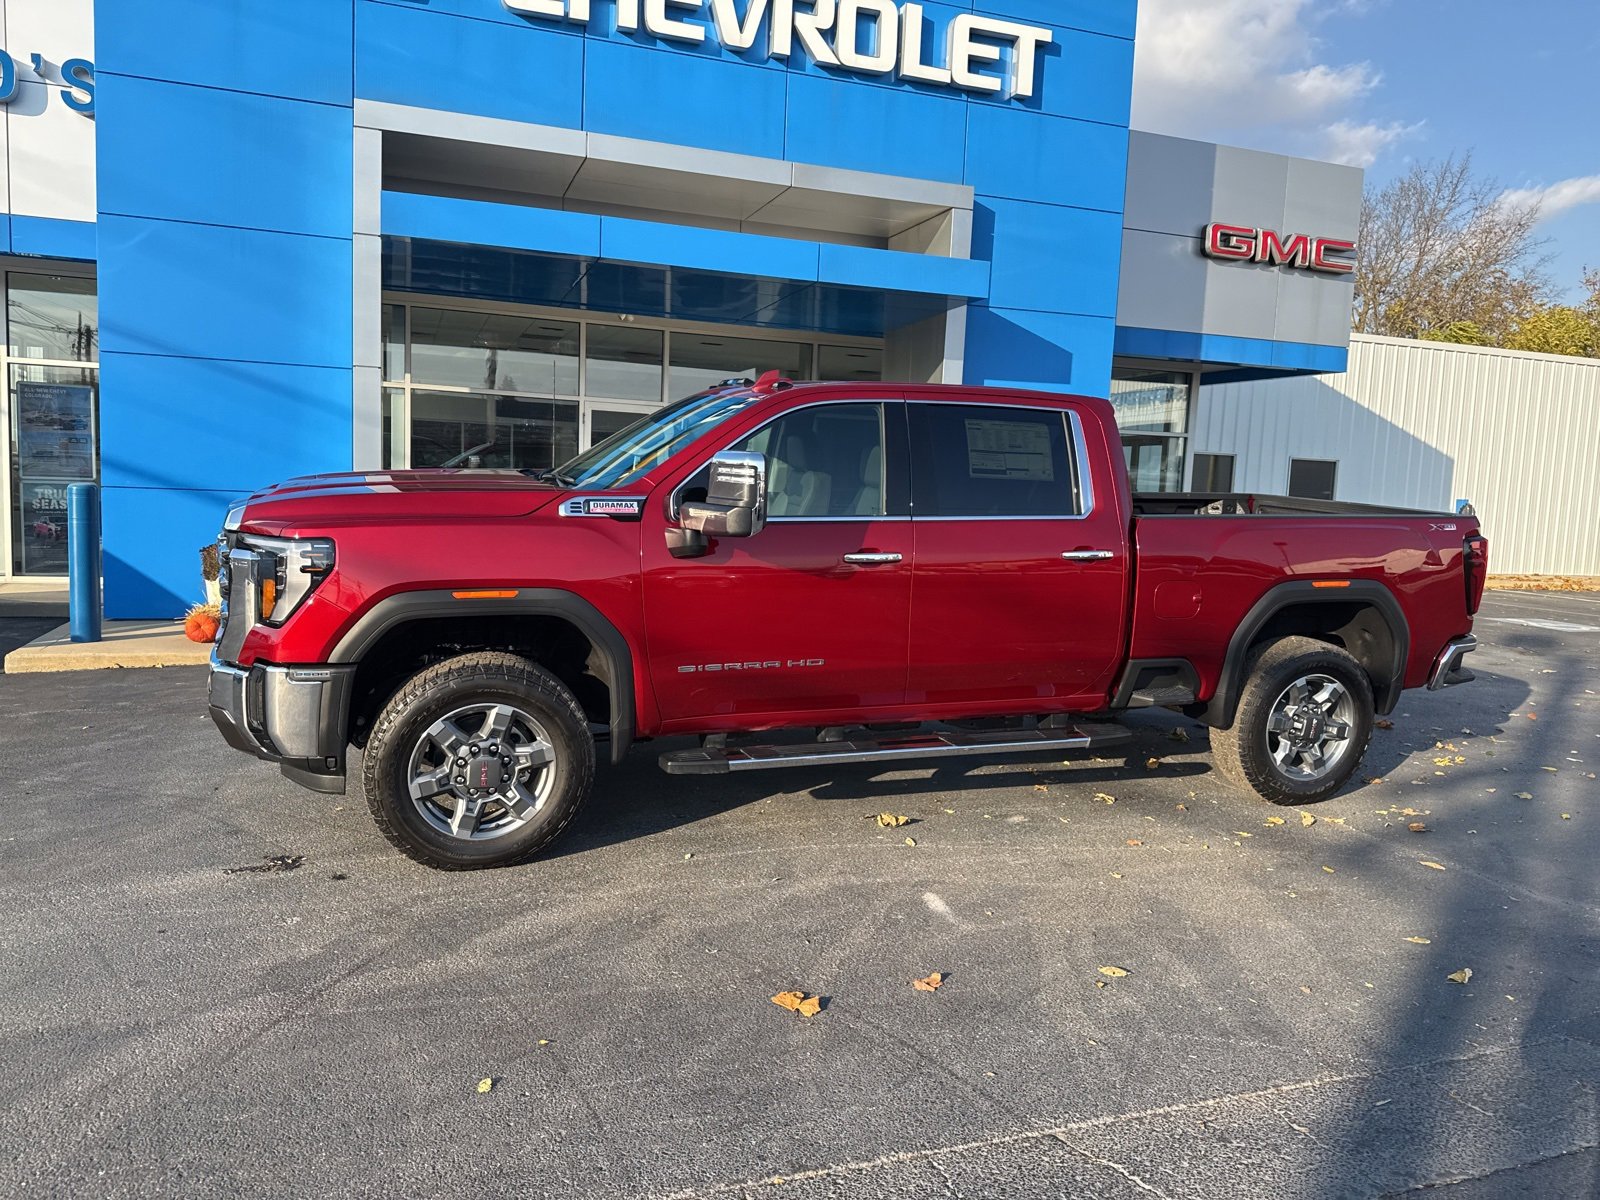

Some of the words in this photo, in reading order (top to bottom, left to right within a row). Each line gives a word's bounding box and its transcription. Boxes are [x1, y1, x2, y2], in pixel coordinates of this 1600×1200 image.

[504, 0, 1052, 98] EVROLET
[1205, 222, 1355, 273] GMC
[34, 488, 68, 499] TRU
[32, 499, 68, 509] SEAS
[678, 660, 781, 672] SIERRA
[787, 659, 824, 667] HD
